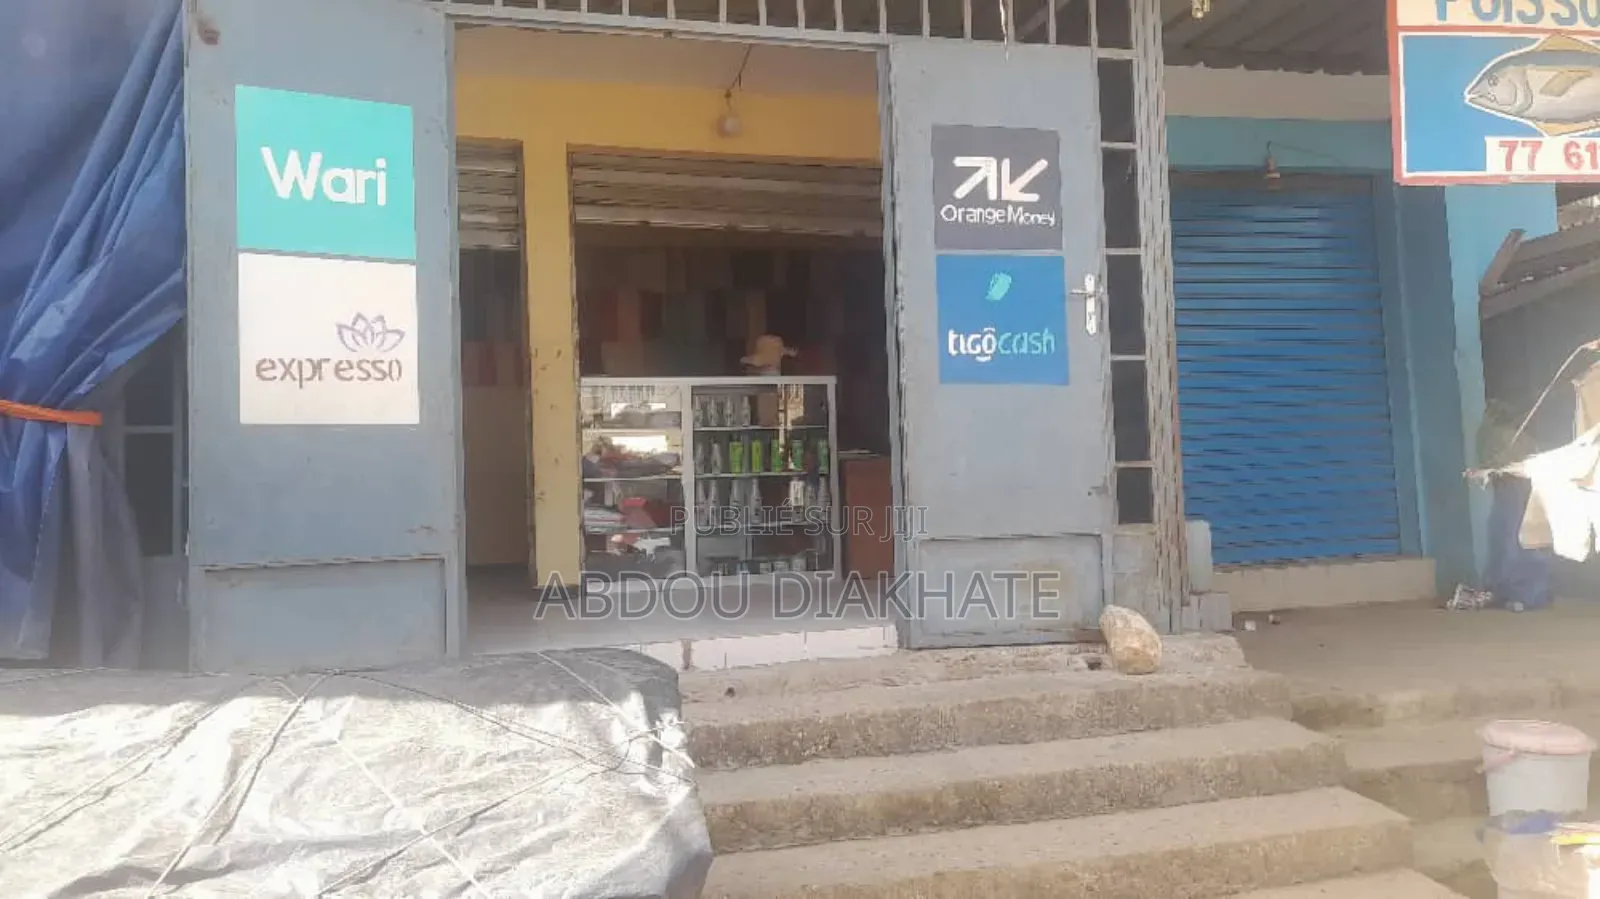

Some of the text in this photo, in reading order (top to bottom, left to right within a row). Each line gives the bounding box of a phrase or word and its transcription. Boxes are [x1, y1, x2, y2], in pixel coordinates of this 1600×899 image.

[1498, 140, 1543, 171] 77
[260, 146, 388, 206] Wari
[255, 356, 403, 390] expresso
